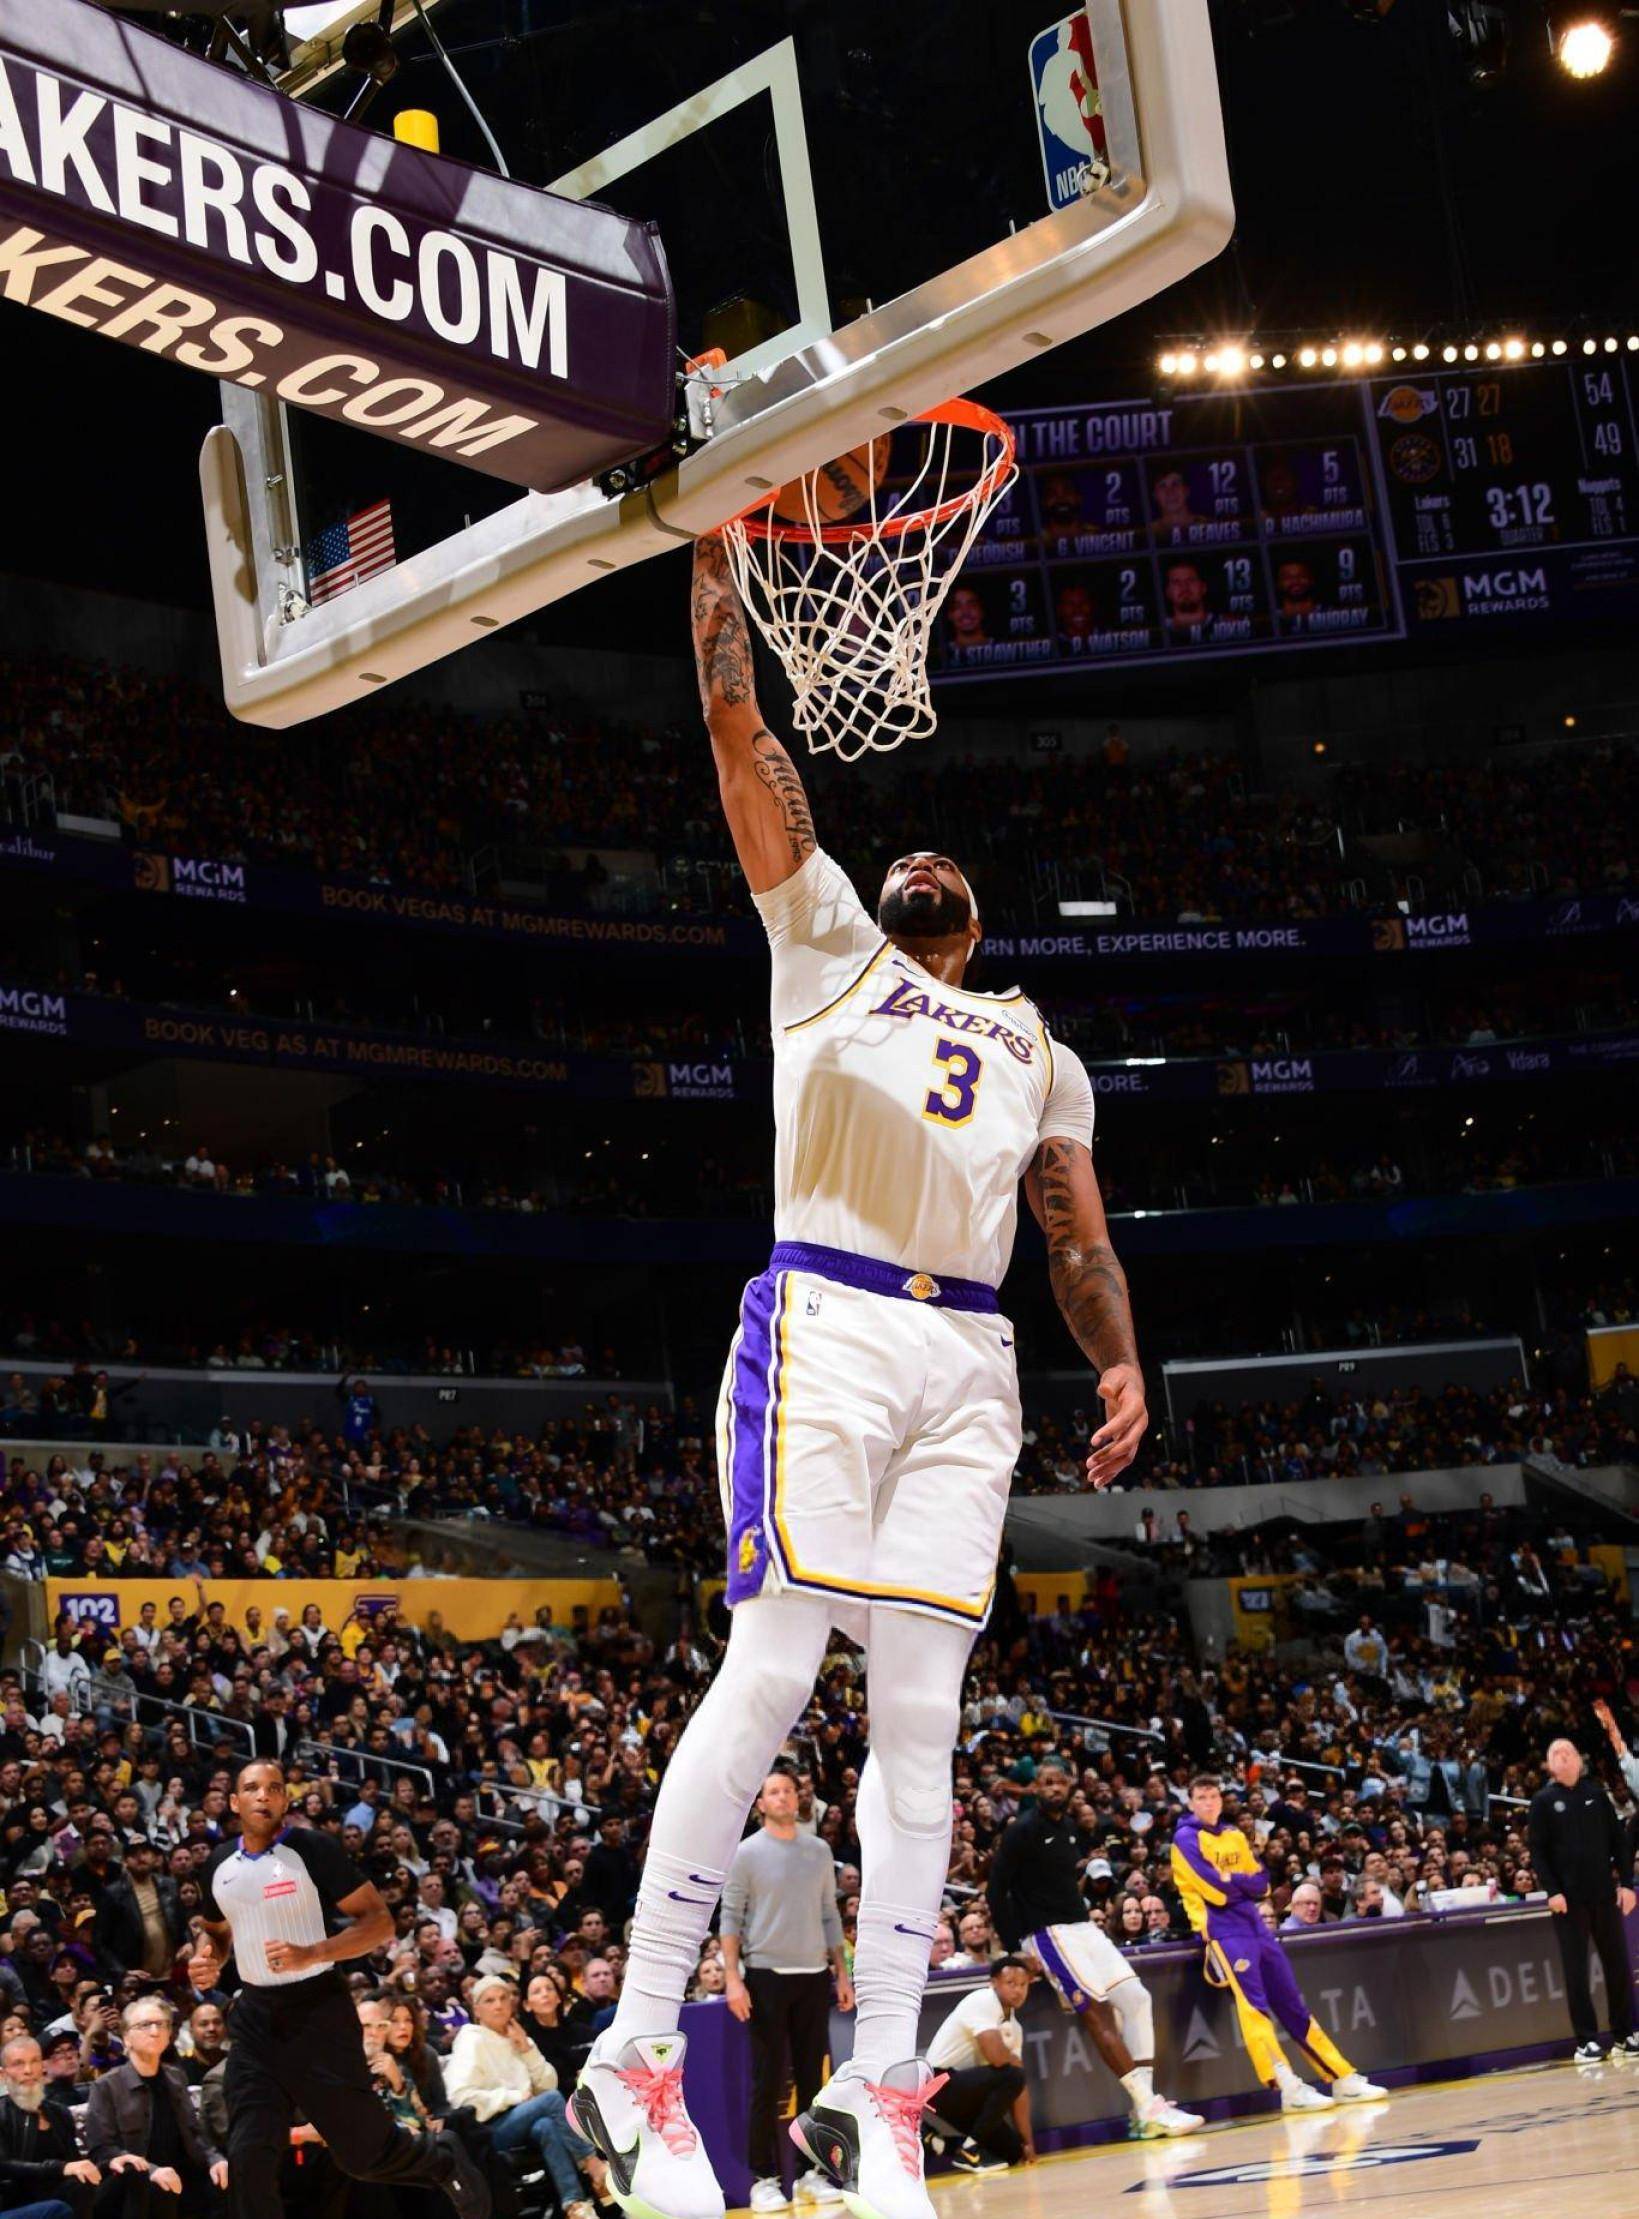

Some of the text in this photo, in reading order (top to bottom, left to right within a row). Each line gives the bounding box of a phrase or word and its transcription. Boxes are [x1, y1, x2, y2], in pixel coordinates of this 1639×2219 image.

[1447, 387, 1470, 419] 27
[1478, 384, 1500, 416] 27
[1584, 372, 1613, 406] 54
[1031, 417, 1080, 456] THE
[1086, 411, 1172, 449] COURT
[1594, 422, 1622, 456] 49
[1322, 451, 1339, 483] 5
[1454, 437, 1478, 470] 31
[1105, 471, 1122, 505] 2
[1208, 461, 1237, 495] 12
[1214, 496, 1239, 517] PTS
[1323, 485, 1348, 506] PTS
[1486, 483, 1555, 529] 3:12
[1105, 505, 1131, 526] PTS
[1188, 519, 1242, 544] REAVES
[1075, 530, 1136, 554] VINCENT
[1223, 557, 1251, 592] 13
[1338, 546, 1354, 580] 9
[1009, 579, 1027, 613] 3
[1120, 569, 1136, 603] 2
[1463, 568, 1547, 600] MGM
[1467, 595, 1551, 617] REWARDS
[966, 638, 1051, 664] STRAWTHER
[1089, 629, 1150, 652] WATSON
[172, 857, 244, 888] MGM
[175, 883, 247, 902] REWARDS
[322, 886, 726, 945] BOOK VEGAS AT MGMREWARDS.COM
[1405, 913, 1469, 936] MGM
[980, 938, 1015, 956] RN
[1097, 930, 1231, 953] EXPERIENCE
[1237, 928, 1306, 949] MORE.
[1408, 933, 1472, 949] REWARDS
[0, 987, 66, 1020] MGM
[867, 978, 1034, 1065] LAKERS
[144, 1018, 214, 1044] BOOK
[312, 1038, 341, 1058] AT
[347, 1042, 568, 1081] MGMREWARDS.COM
[668, 1063, 733, 1086] MGM
[922, 1035, 986, 1129] 3
[1092, 1074, 1149, 1094] ORE.
[1252, 1060, 1312, 1081] MGM
[671, 1085, 735, 1100] REWARDS
[66, 1598, 116, 1623] 102
[1488, 1951, 1605, 2008] DELA
